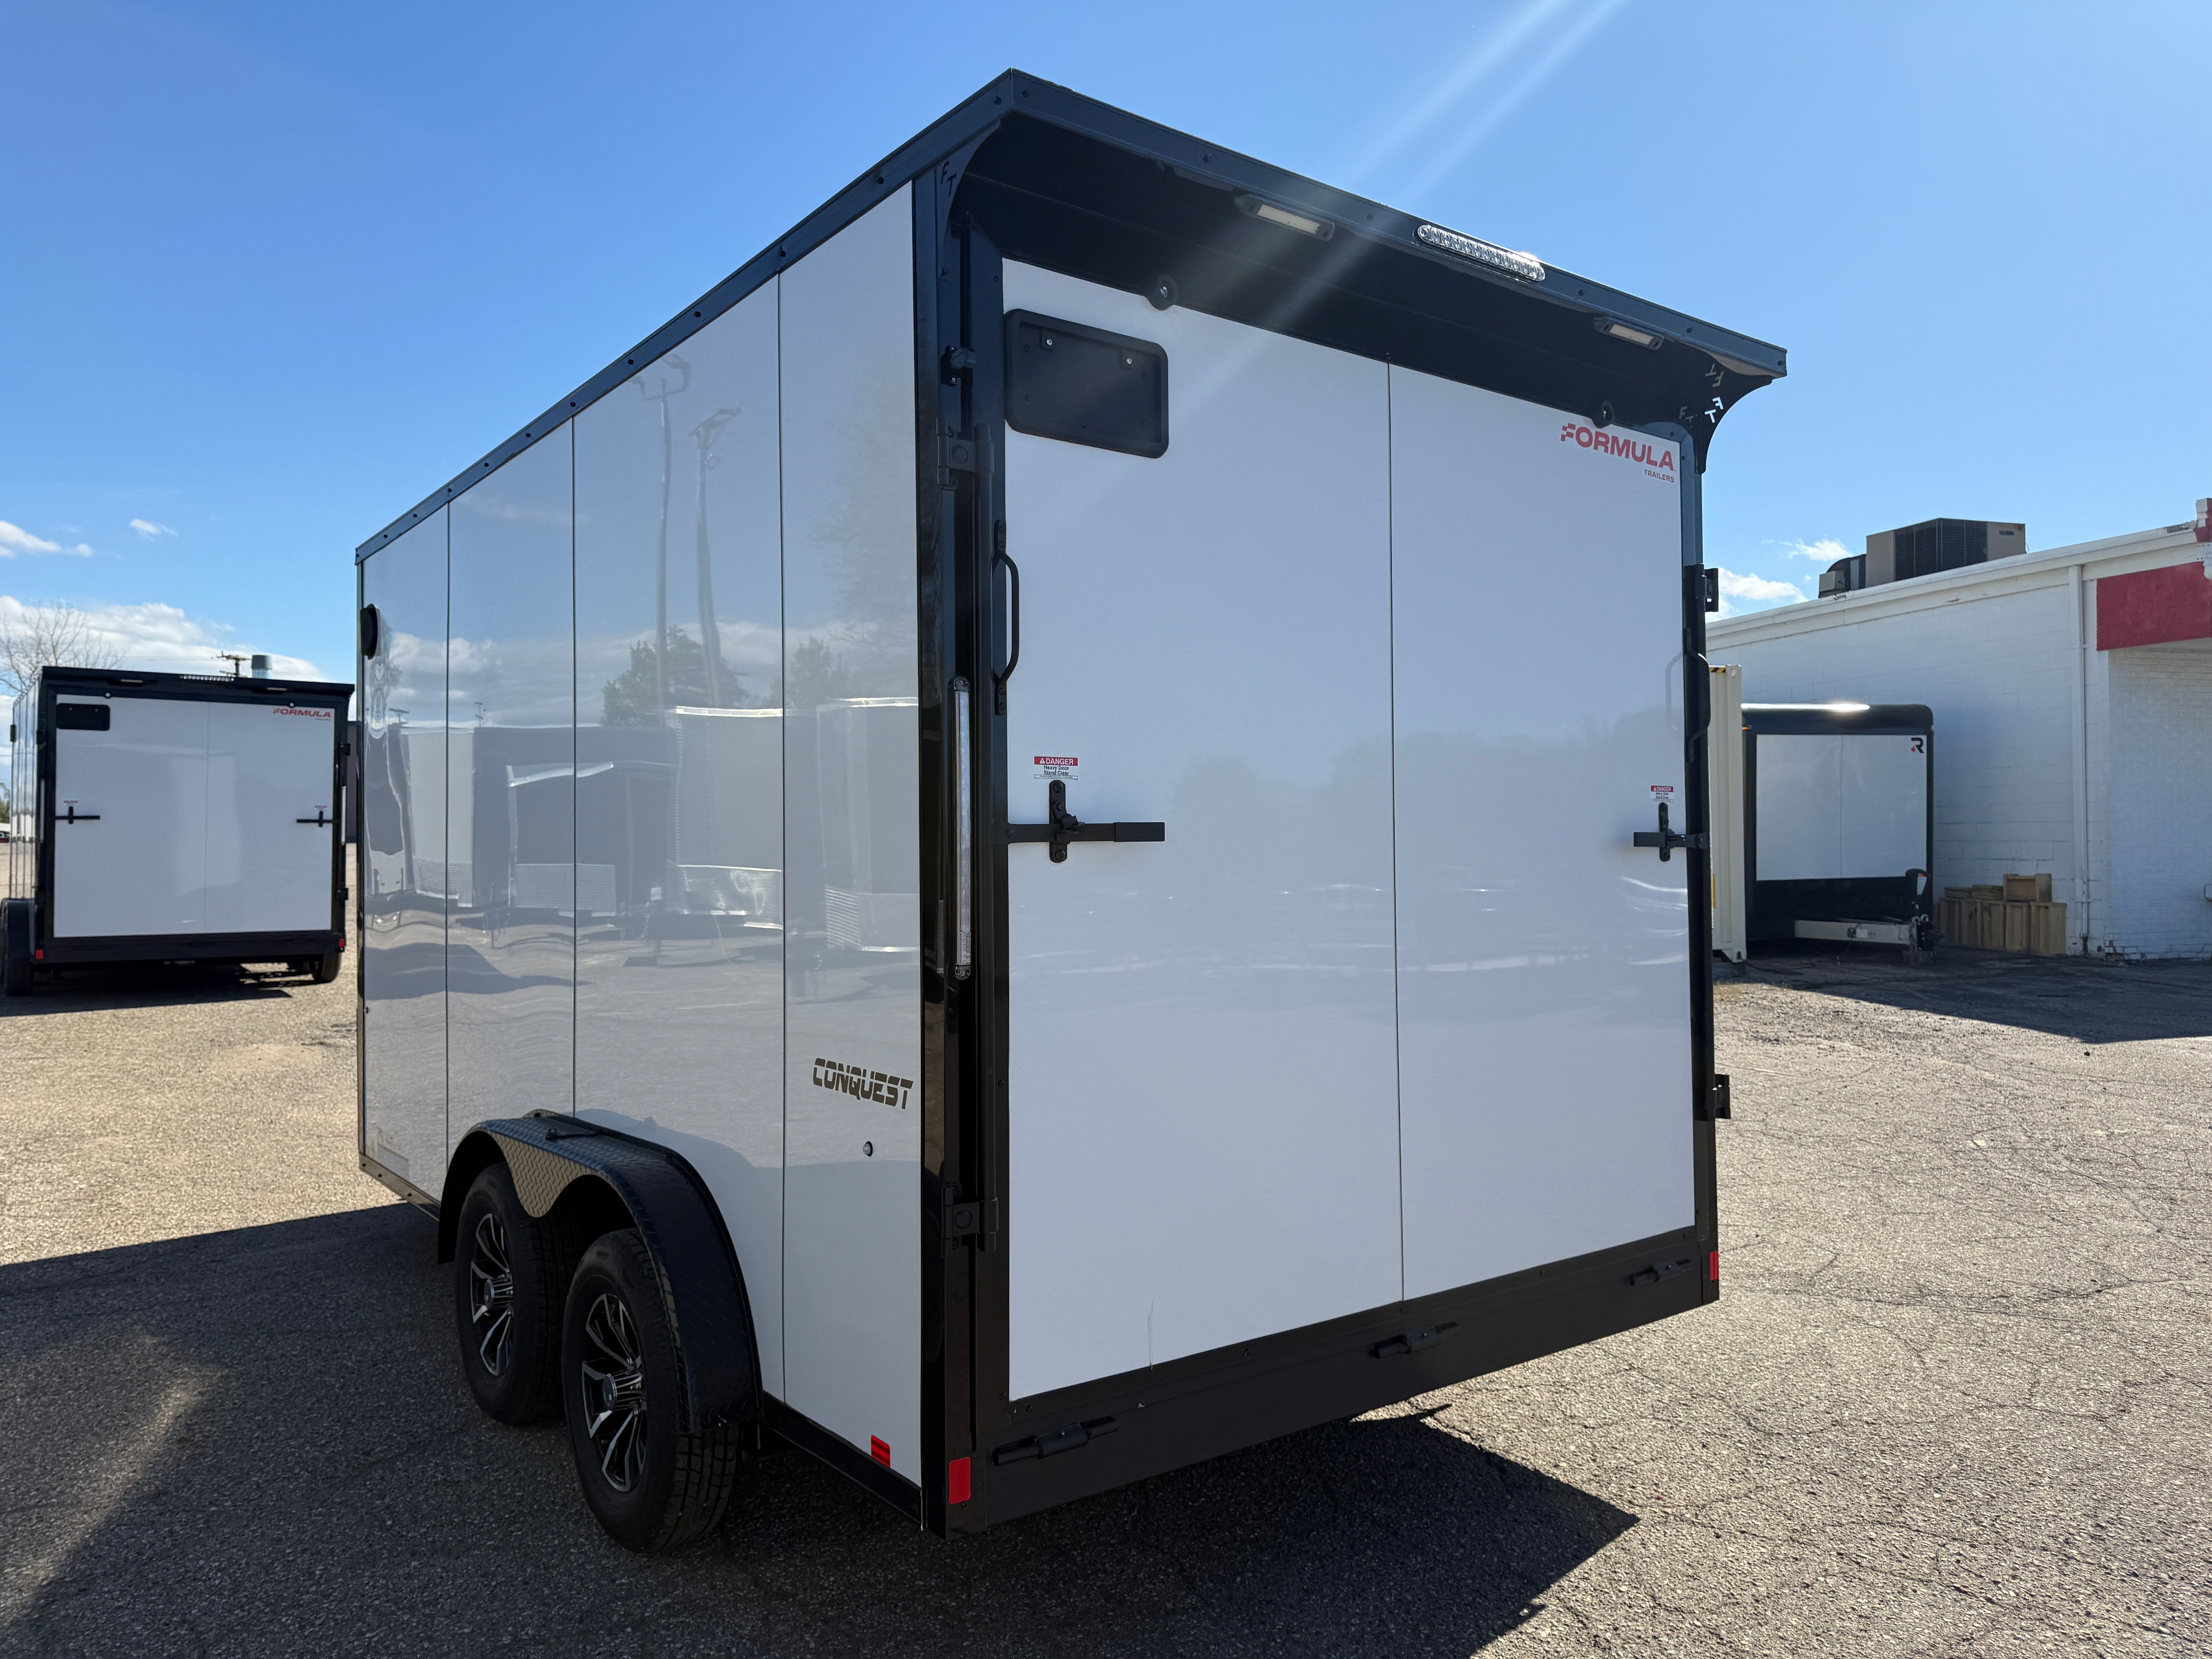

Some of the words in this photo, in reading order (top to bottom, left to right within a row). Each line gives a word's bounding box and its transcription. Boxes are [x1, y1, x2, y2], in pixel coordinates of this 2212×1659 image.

[1561, 423, 1674, 471] FORMULA
[1644, 469, 1674, 483] TRAILERS
[273, 708, 331, 717] FORMULA
[813, 1058, 914, 1109] CONQUEST
